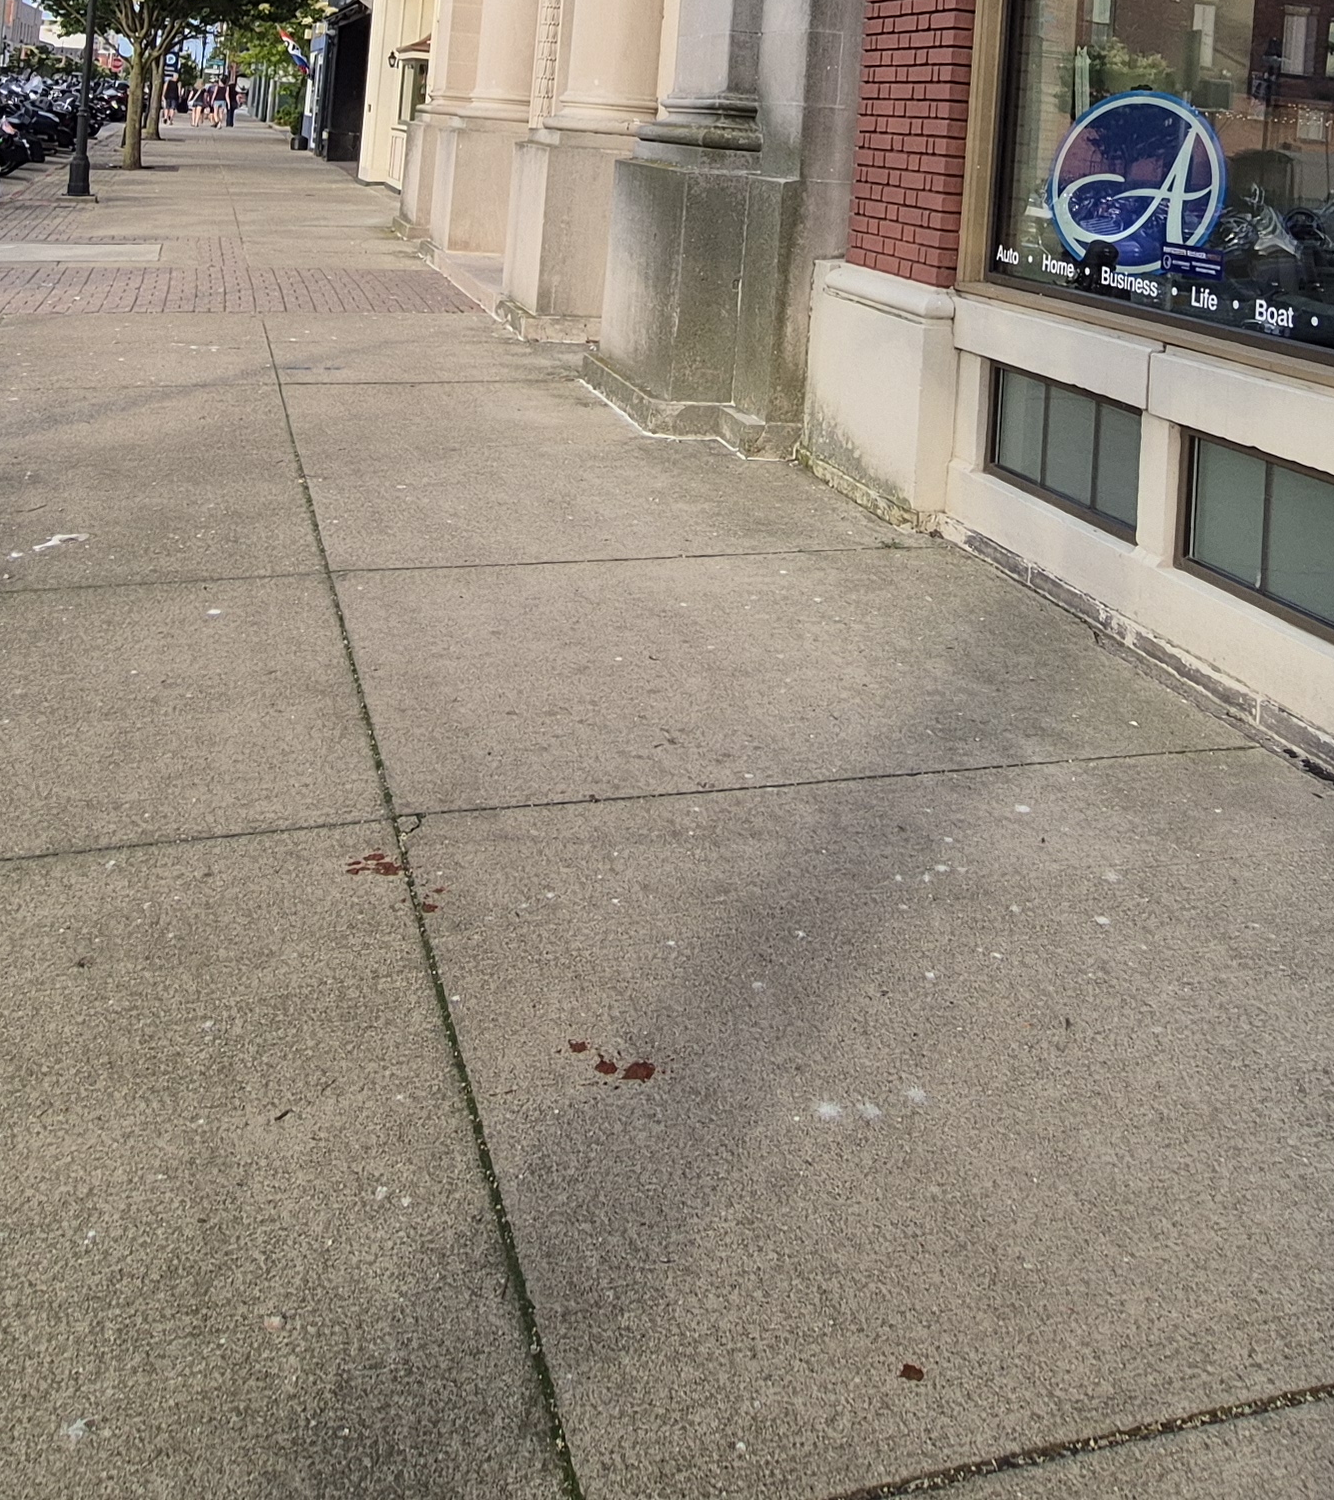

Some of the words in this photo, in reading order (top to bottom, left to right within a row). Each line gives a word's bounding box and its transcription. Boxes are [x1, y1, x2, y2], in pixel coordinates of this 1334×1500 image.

[996, 244, 1019, 265] Auto
[1042, 255, 1075, 278] Home
[1101, 267, 1158, 298] Business
[1191, 286, 1218, 311] Life
[1255, 299, 1294, 328] Boat
